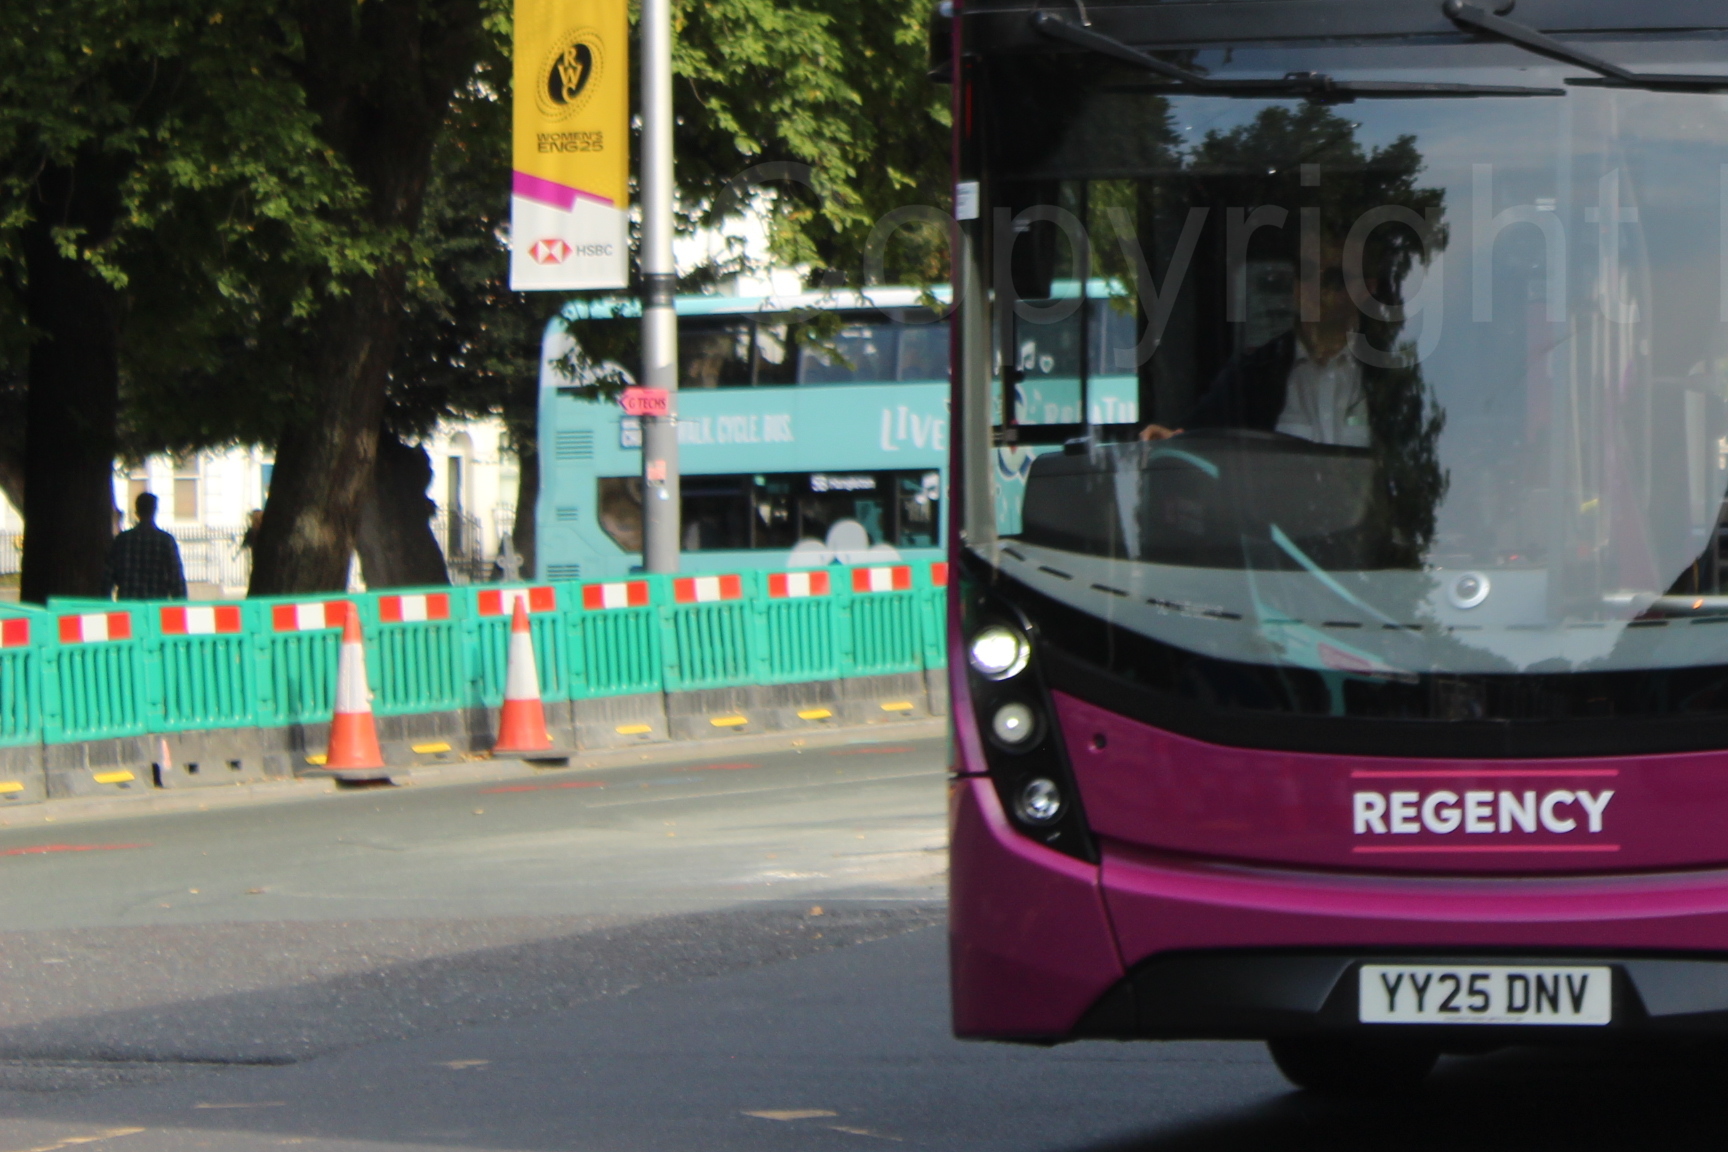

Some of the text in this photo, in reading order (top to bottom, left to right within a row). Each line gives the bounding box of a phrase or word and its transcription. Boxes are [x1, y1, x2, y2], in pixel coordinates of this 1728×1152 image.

[536, 131, 604, 143] WOMEN'S
[537, 141, 605, 154] ENG25
[575, 244, 614, 257] HSBC
[880, 405, 947, 451] LIVE
[1353, 789, 1614, 835] REGENCY
[1381, 971, 1590, 1014] YY25 DNV
